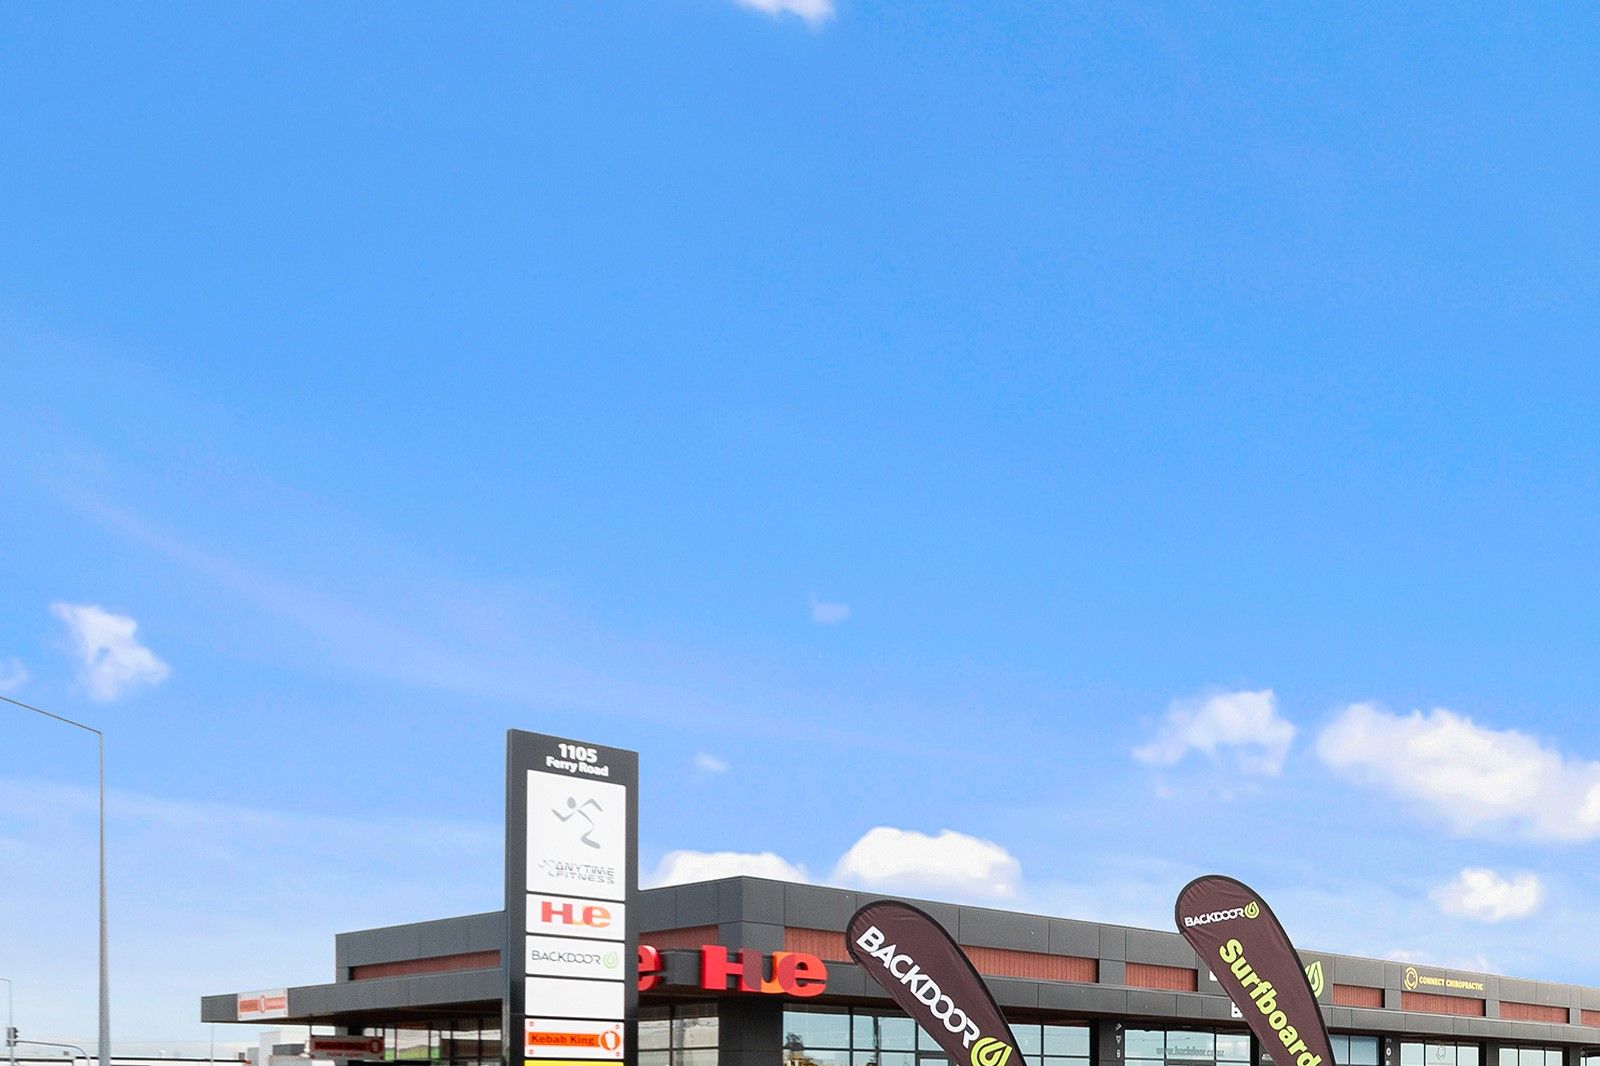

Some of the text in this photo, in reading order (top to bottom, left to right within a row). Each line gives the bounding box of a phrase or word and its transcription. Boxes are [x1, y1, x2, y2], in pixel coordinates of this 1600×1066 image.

[559, 743, 598, 763] 1105
[545, 755, 609, 777] Ferry Road
[556, 861, 615, 876] ANYTIME
[556, 870, 615, 885] FITNESS
[1185, 907, 1246, 927] BACKDOOR
[532, 949, 601, 965] BACKDOOR
[856, 926, 981, 1049] BACKDOOR
[1418, 975, 1484, 991] CONNECT CHIROPRACTIC
[531, 1034, 595, 1046] Kebab King
